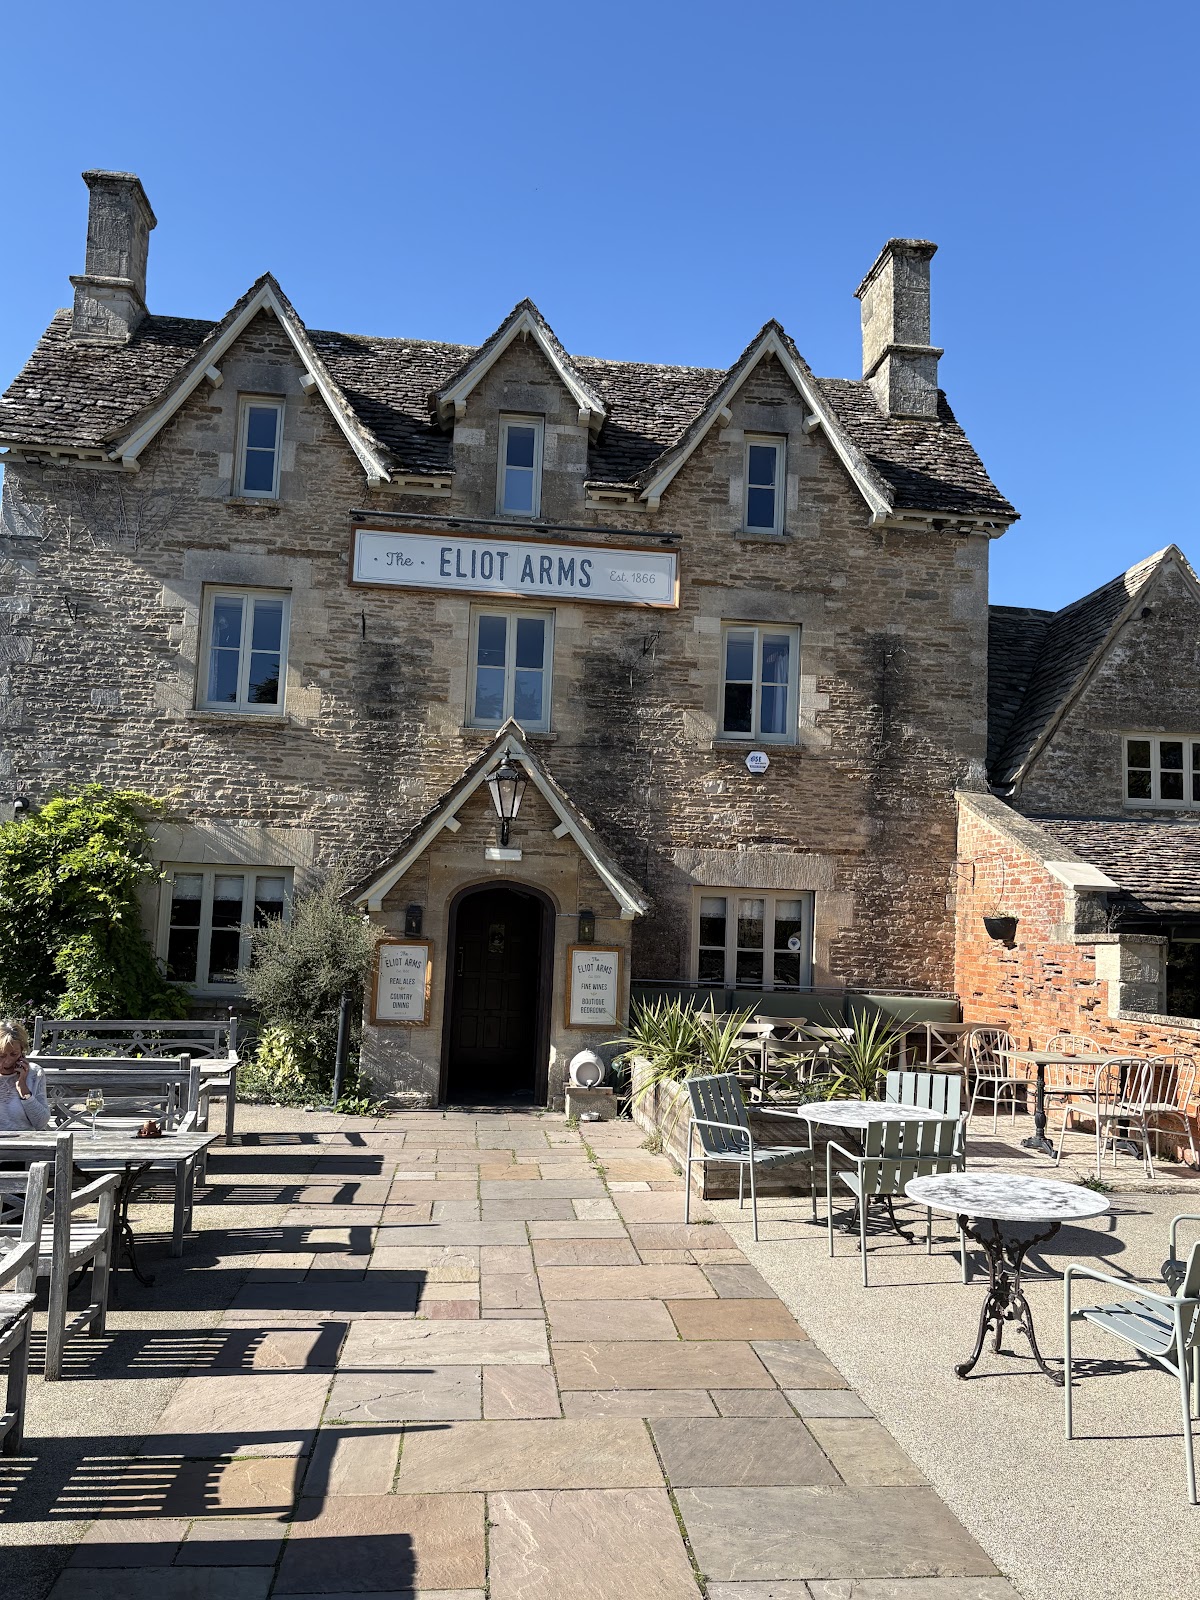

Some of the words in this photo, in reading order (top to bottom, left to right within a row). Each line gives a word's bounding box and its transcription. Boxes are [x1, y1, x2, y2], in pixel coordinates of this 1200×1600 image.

[386, 551, 414, 568] The
[439, 547, 509, 582] ELIOT
[520, 554, 593, 588] ARMS
[609, 570, 629, 584] Est.
[631, 572, 656, 585] 1866
[385, 957, 403, 968] ELIOT
[404, 958, 422, 969] ARMS
[577, 963, 594, 974] ELIOT
[595, 963, 613, 975] ARMS
[389, 977, 402, 985] REAL
[592, 983, 608, 991] WINES
[389, 993, 413, 1001] COUNTRY
[392, 1001, 410, 1009] DINING
[581, 998, 605, 1006] BOUTIQUE
[580, 1006, 607, 1014] BEDROOMS
